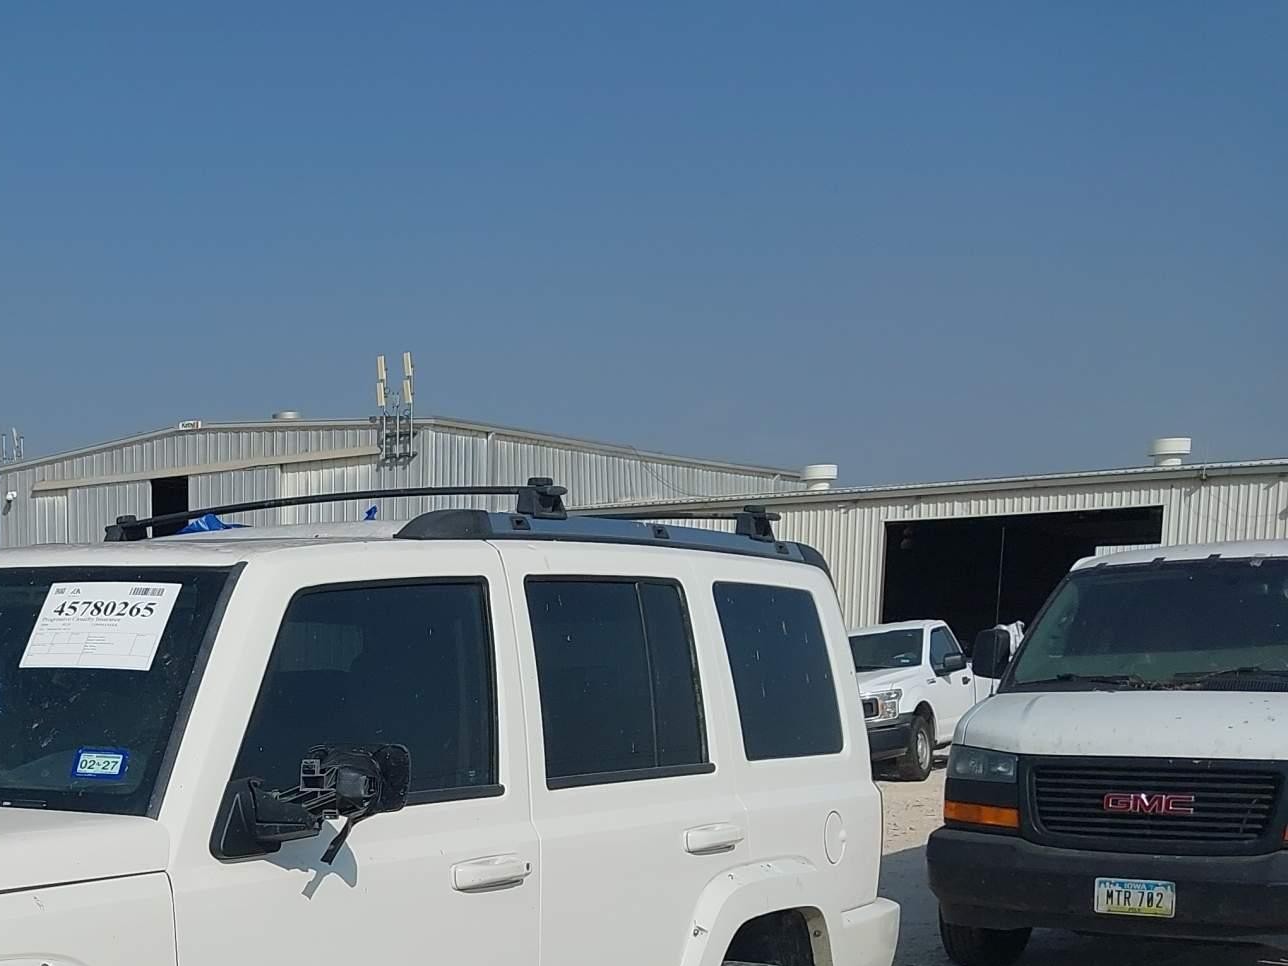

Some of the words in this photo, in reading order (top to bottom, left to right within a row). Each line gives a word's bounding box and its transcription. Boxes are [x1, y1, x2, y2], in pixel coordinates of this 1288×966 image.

[52, 600, 158, 618] 45780265
[1104, 793, 1195, 815] GMC
[1106, 889, 1131, 906] MTR
[1138, 891, 1164, 909] 702
